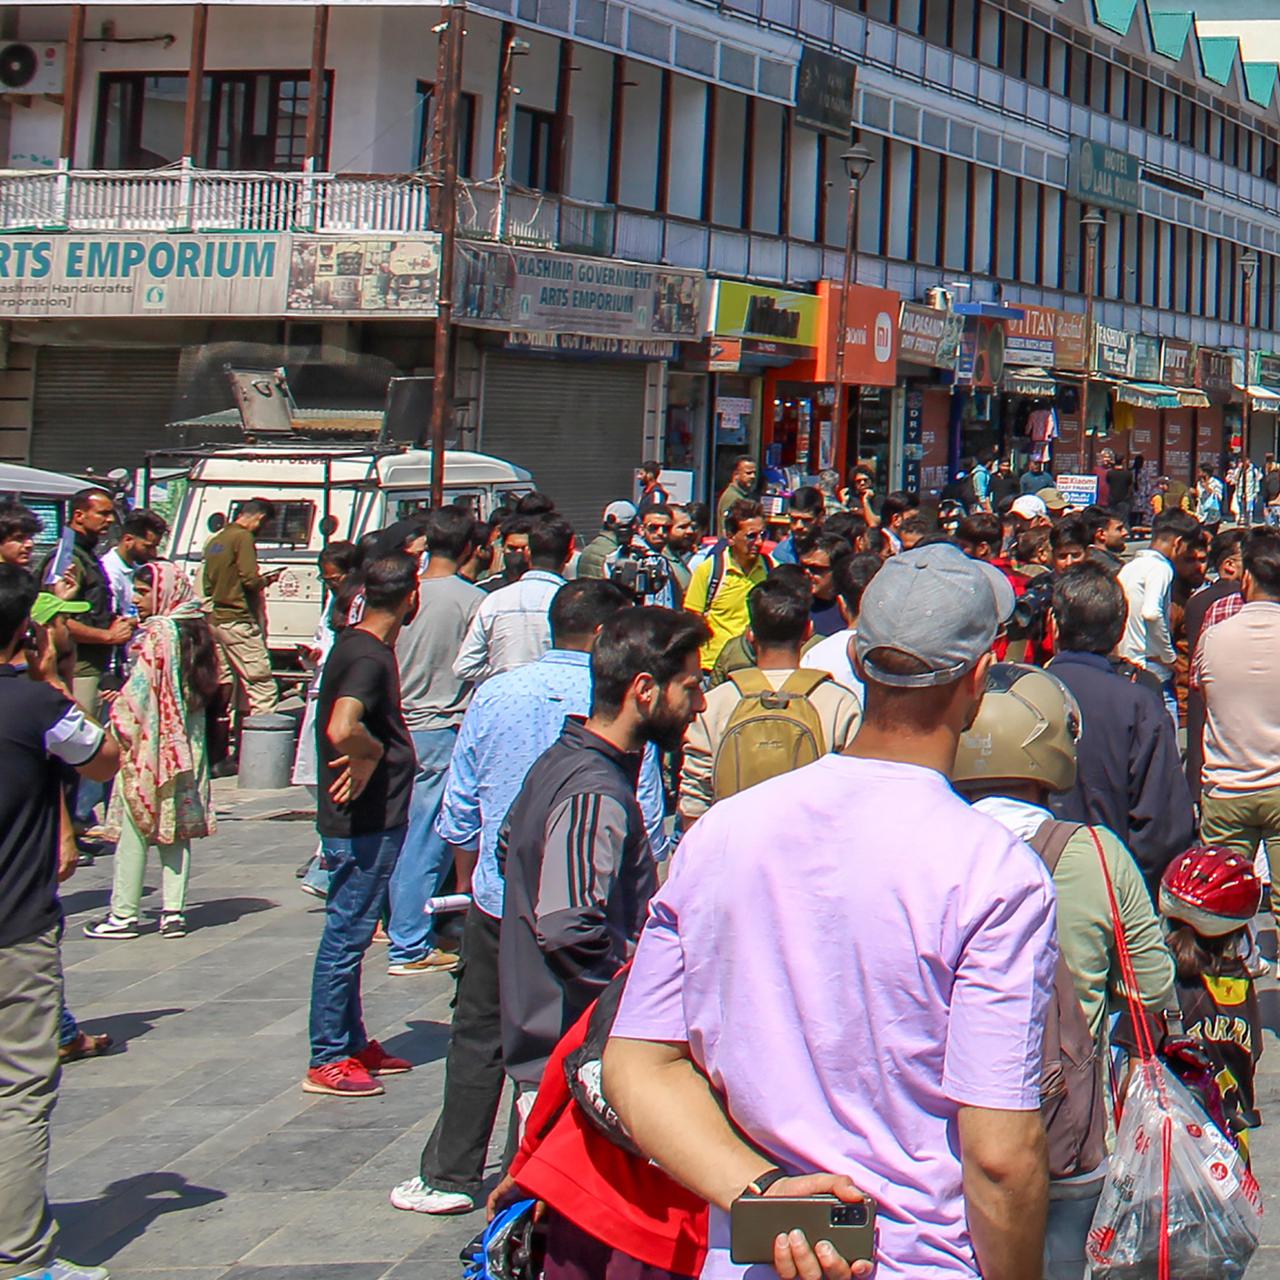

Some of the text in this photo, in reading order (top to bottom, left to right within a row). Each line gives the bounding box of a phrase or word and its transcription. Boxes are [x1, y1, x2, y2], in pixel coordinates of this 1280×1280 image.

[66, 241, 276, 278] EMPORIUM
[518, 256, 653, 289] KASHMIR GOVERNMENT
[52, 284, 133, 294] Handicrafts
[539, 286, 634, 313] ARTS EMPORIUM
[836, 325, 867, 346] aomi
